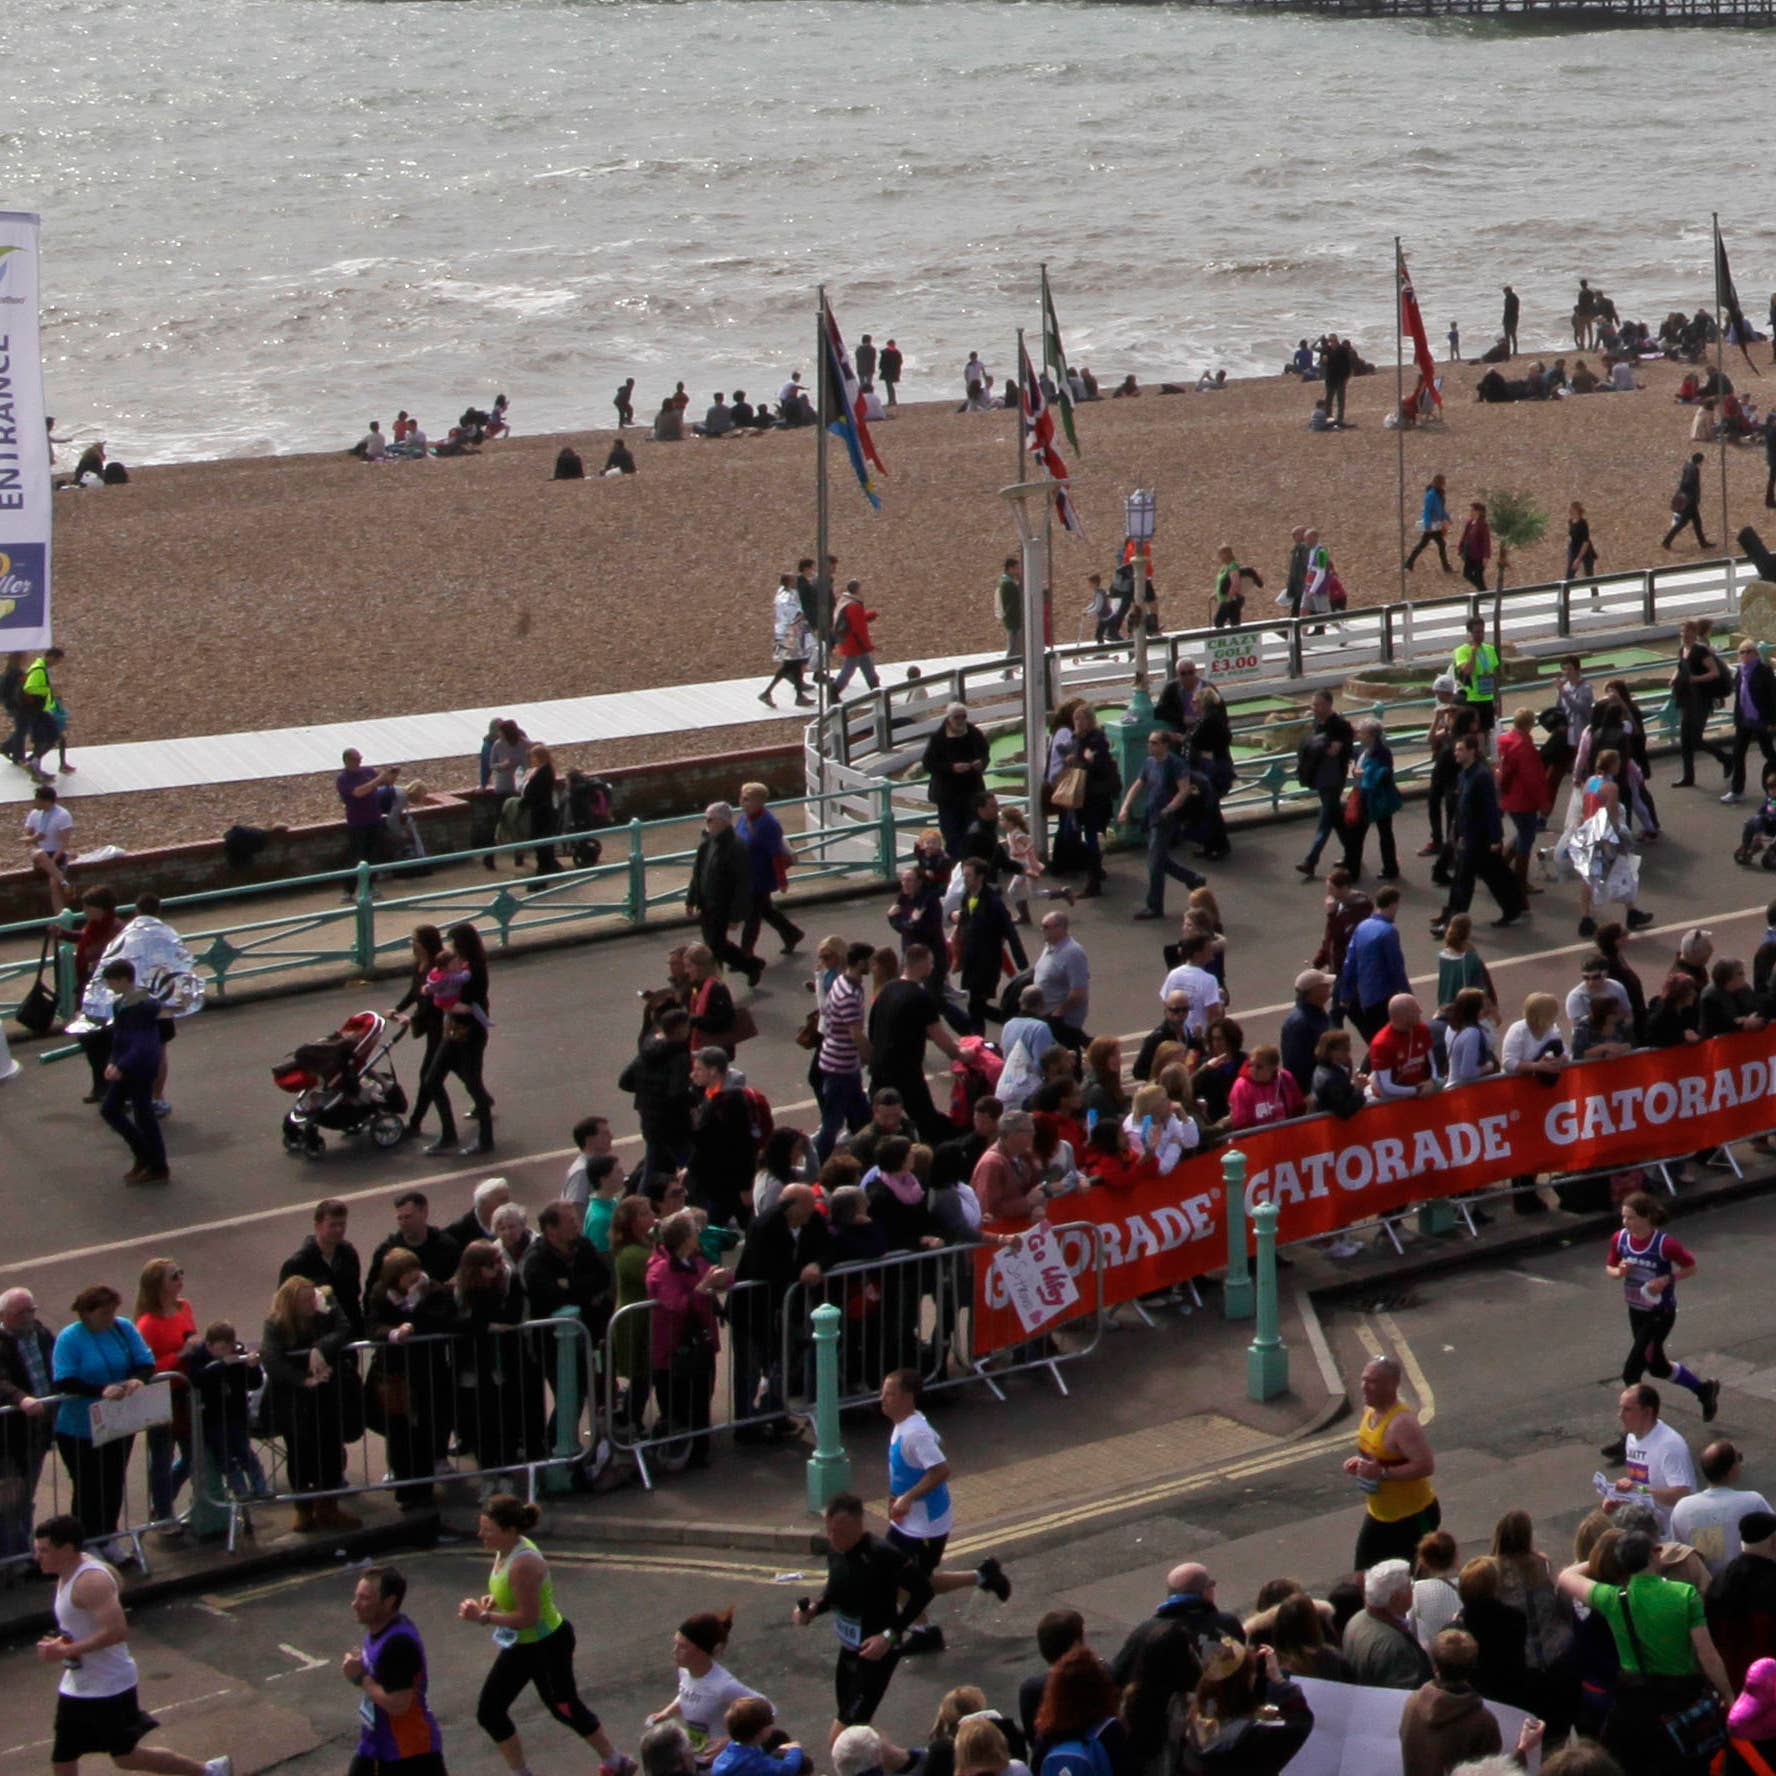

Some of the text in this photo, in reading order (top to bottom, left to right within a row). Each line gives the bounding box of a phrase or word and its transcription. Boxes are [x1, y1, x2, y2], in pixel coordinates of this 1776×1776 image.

[1208, 635, 1257, 649] CRAZY
[1215, 646, 1252, 658] GOLF
[1212, 655, 1257, 672] £3.00
[984, 1195, 1217, 1311] GORADE
[1244, 1114, 1512, 1211] GATORADE
[1027, 1233, 1049, 1264] Go
